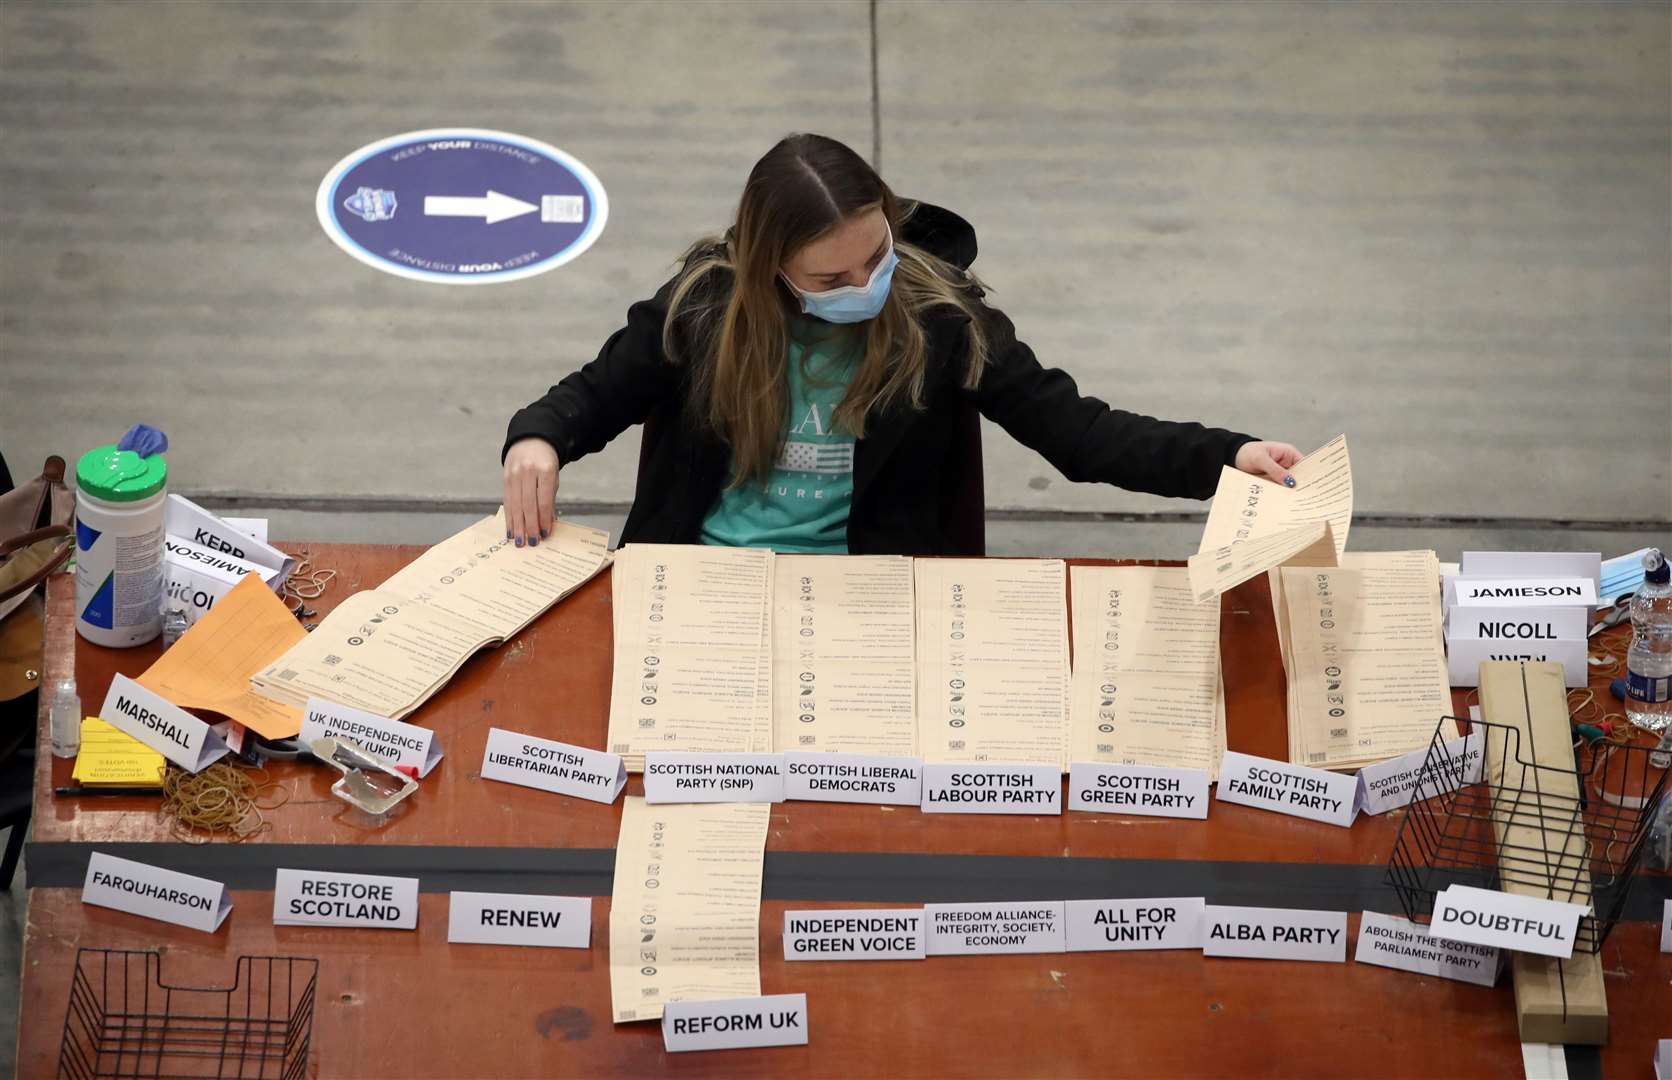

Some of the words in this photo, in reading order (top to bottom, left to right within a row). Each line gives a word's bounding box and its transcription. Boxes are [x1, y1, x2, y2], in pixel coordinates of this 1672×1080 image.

[427, 141, 472, 150] YOUR
[474, 141, 539, 164] DISTANCE
[458, 262, 502, 272] YOUR
[165, 541, 252, 576] AMIESON
[1469, 586, 1582, 598] JAMIESON
[1478, 622, 1557, 639] NICOLL
[115, 696, 192, 749] MARSHALL
[309, 711, 327, 725] UK
[329, 717, 424, 751] INDEPENDENCE
[365, 742, 403, 761] (UKIP)
[521, 744, 584, 766] SCOTTISH
[488, 752, 568, 779] LIBERTARIAN
[571, 770, 612, 788] PARTY
[649, 764, 711, 775] SCOTTISH
[716, 764, 780, 776] NATIONAL
[789, 763, 858, 777] SCOTTISH
[861, 766, 917, 780] LIBERAL
[676, 778, 717, 789] PARTY
[720, 778, 754, 791] (SNP)
[809, 778, 896, 793] DEMOCRATS
[951, 773, 1033, 787] SCOTTISH
[1097, 774, 1180, 792] SCOTTISH
[1247, 767, 1329, 795] SCOTTISH
[1369, 770, 1413, 791] SCOTTISH
[928, 789, 998, 803] LABOUR
[1002, 790, 1056, 803] PARTY
[1080, 789, 1137, 805] GREEN
[1141, 793, 1195, 808] PARTY
[1228, 779, 1287, 802] FAMILY
[1289, 791, 1342, 813] PARTY
[1381, 785, 1400, 798] AND
[92, 871, 213, 912] FARQUHARSON
[301, 879, 393, 901] RESTORE
[289, 899, 400, 922] SCOTLAND
[480, 909, 562, 928] RENEW
[935, 911, 993, 922] FREEDOM
[1094, 909, 1130, 924] ALL
[1136, 907, 1176, 923] FOR
[790, 918, 919, 934] INDEPENDENT
[936, 923, 1000, 934] INTEGRITY,
[1003, 921, 1056, 933] SOCIETY,
[1105, 925, 1167, 941] UNITY
[1442, 906, 1566, 941] DOUBTFUL
[965, 935, 1027, 946] ECONOMY
[1210, 923, 1266, 941] ALBA
[1272, 926, 1341, 944] PARTY
[1365, 925, 1413, 943] ABOLISH
[1415, 935, 1437, 948] THE
[1439, 938, 1495, 958] SCOTTISH
[793, 938, 855, 952] GREEN
[861, 937, 916, 951] VOICE
[1374, 940, 1443, 963] PARLIAMENT
[1445, 953, 1482, 970] PARTY
[673, 1013, 763, 1035] REFORM
[770, 1011, 800, 1029] UK
